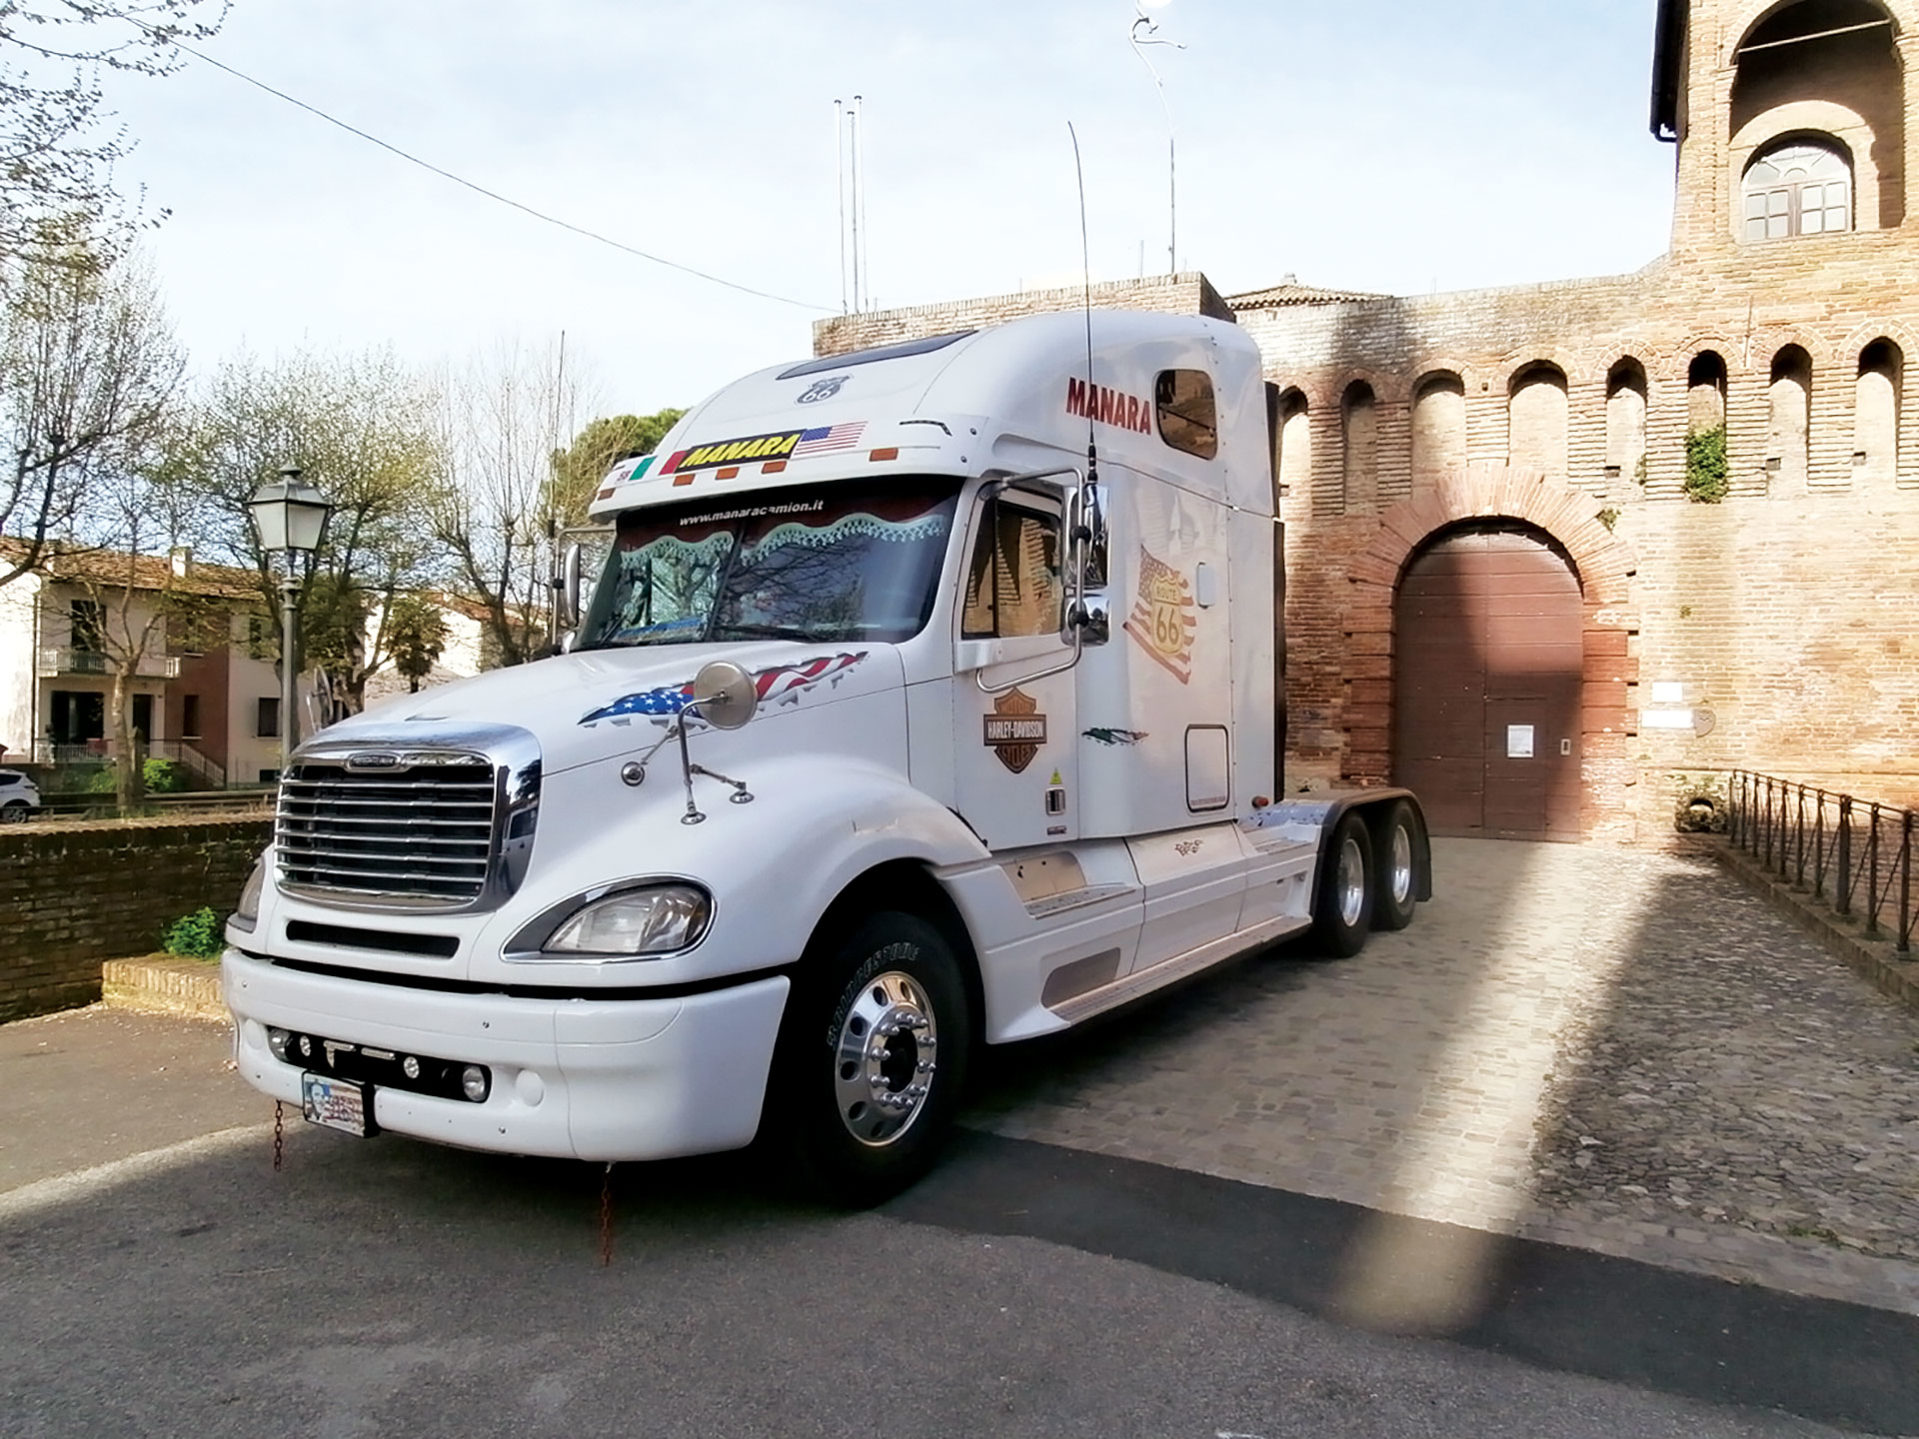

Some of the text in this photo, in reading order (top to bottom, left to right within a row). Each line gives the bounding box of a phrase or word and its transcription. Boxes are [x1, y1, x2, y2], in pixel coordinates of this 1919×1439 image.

[1066, 377, 1151, 435] MANARA
[679, 433, 800, 468] MANARA
[1156, 606, 1180, 645] 66
